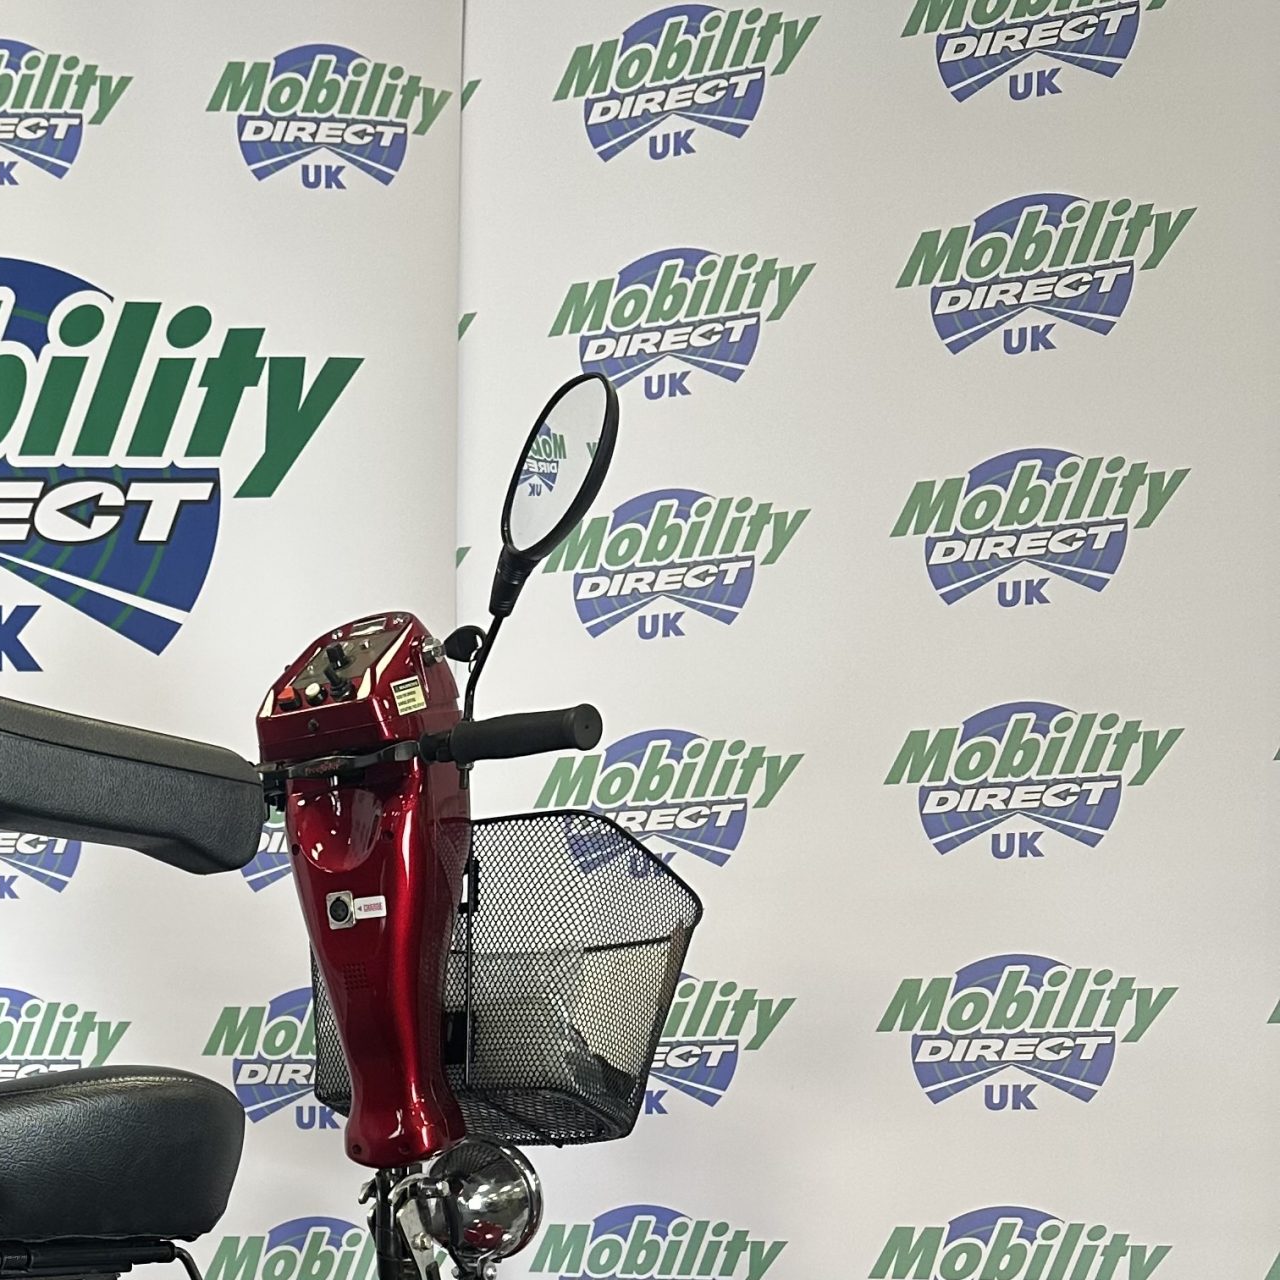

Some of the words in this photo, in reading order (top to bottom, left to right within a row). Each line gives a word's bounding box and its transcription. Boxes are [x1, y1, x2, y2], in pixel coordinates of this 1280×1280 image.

[552, 8, 822, 101] Mobility
[939, 7, 1136, 63] DIRECT
[206, 60, 453, 136] Mobility
[587, 71, 761, 126] DIRECT
[1009, 68, 1062, 100] UK
[240, 121, 405, 148] DIRECT
[648, 128, 696, 160] UK
[301, 165, 347, 190] UK
[895, 199, 1197, 290] Mobility
[547, 254, 817, 337] Mobility
[935, 267, 1130, 316] DIRECT
[582, 318, 756, 364] DIRECT
[1003, 324, 1057, 356] UK
[643, 371, 691, 400] UK
[890, 456, 1191, 537] Mobility
[541, 497, 811, 573] Mobility
[929, 522, 1125, 564] DIRECT
[576, 561, 752, 600] DIRECT
[997, 580, 1050, 608] UK
[637, 611, 685, 640] UK
[883, 713, 1185, 786] Mobility
[534, 740, 804, 809] Mobility
[923, 780, 1118, 815] DIRECT
[991, 830, 1044, 859] UK
[661, 979, 797, 1050] ility
[876, 967, 1179, 1043] Mobility
[914, 1036, 1113, 1063] DIRECT
[296, 1106, 340, 1129] UK
[984, 1085, 1038, 1110] UK
